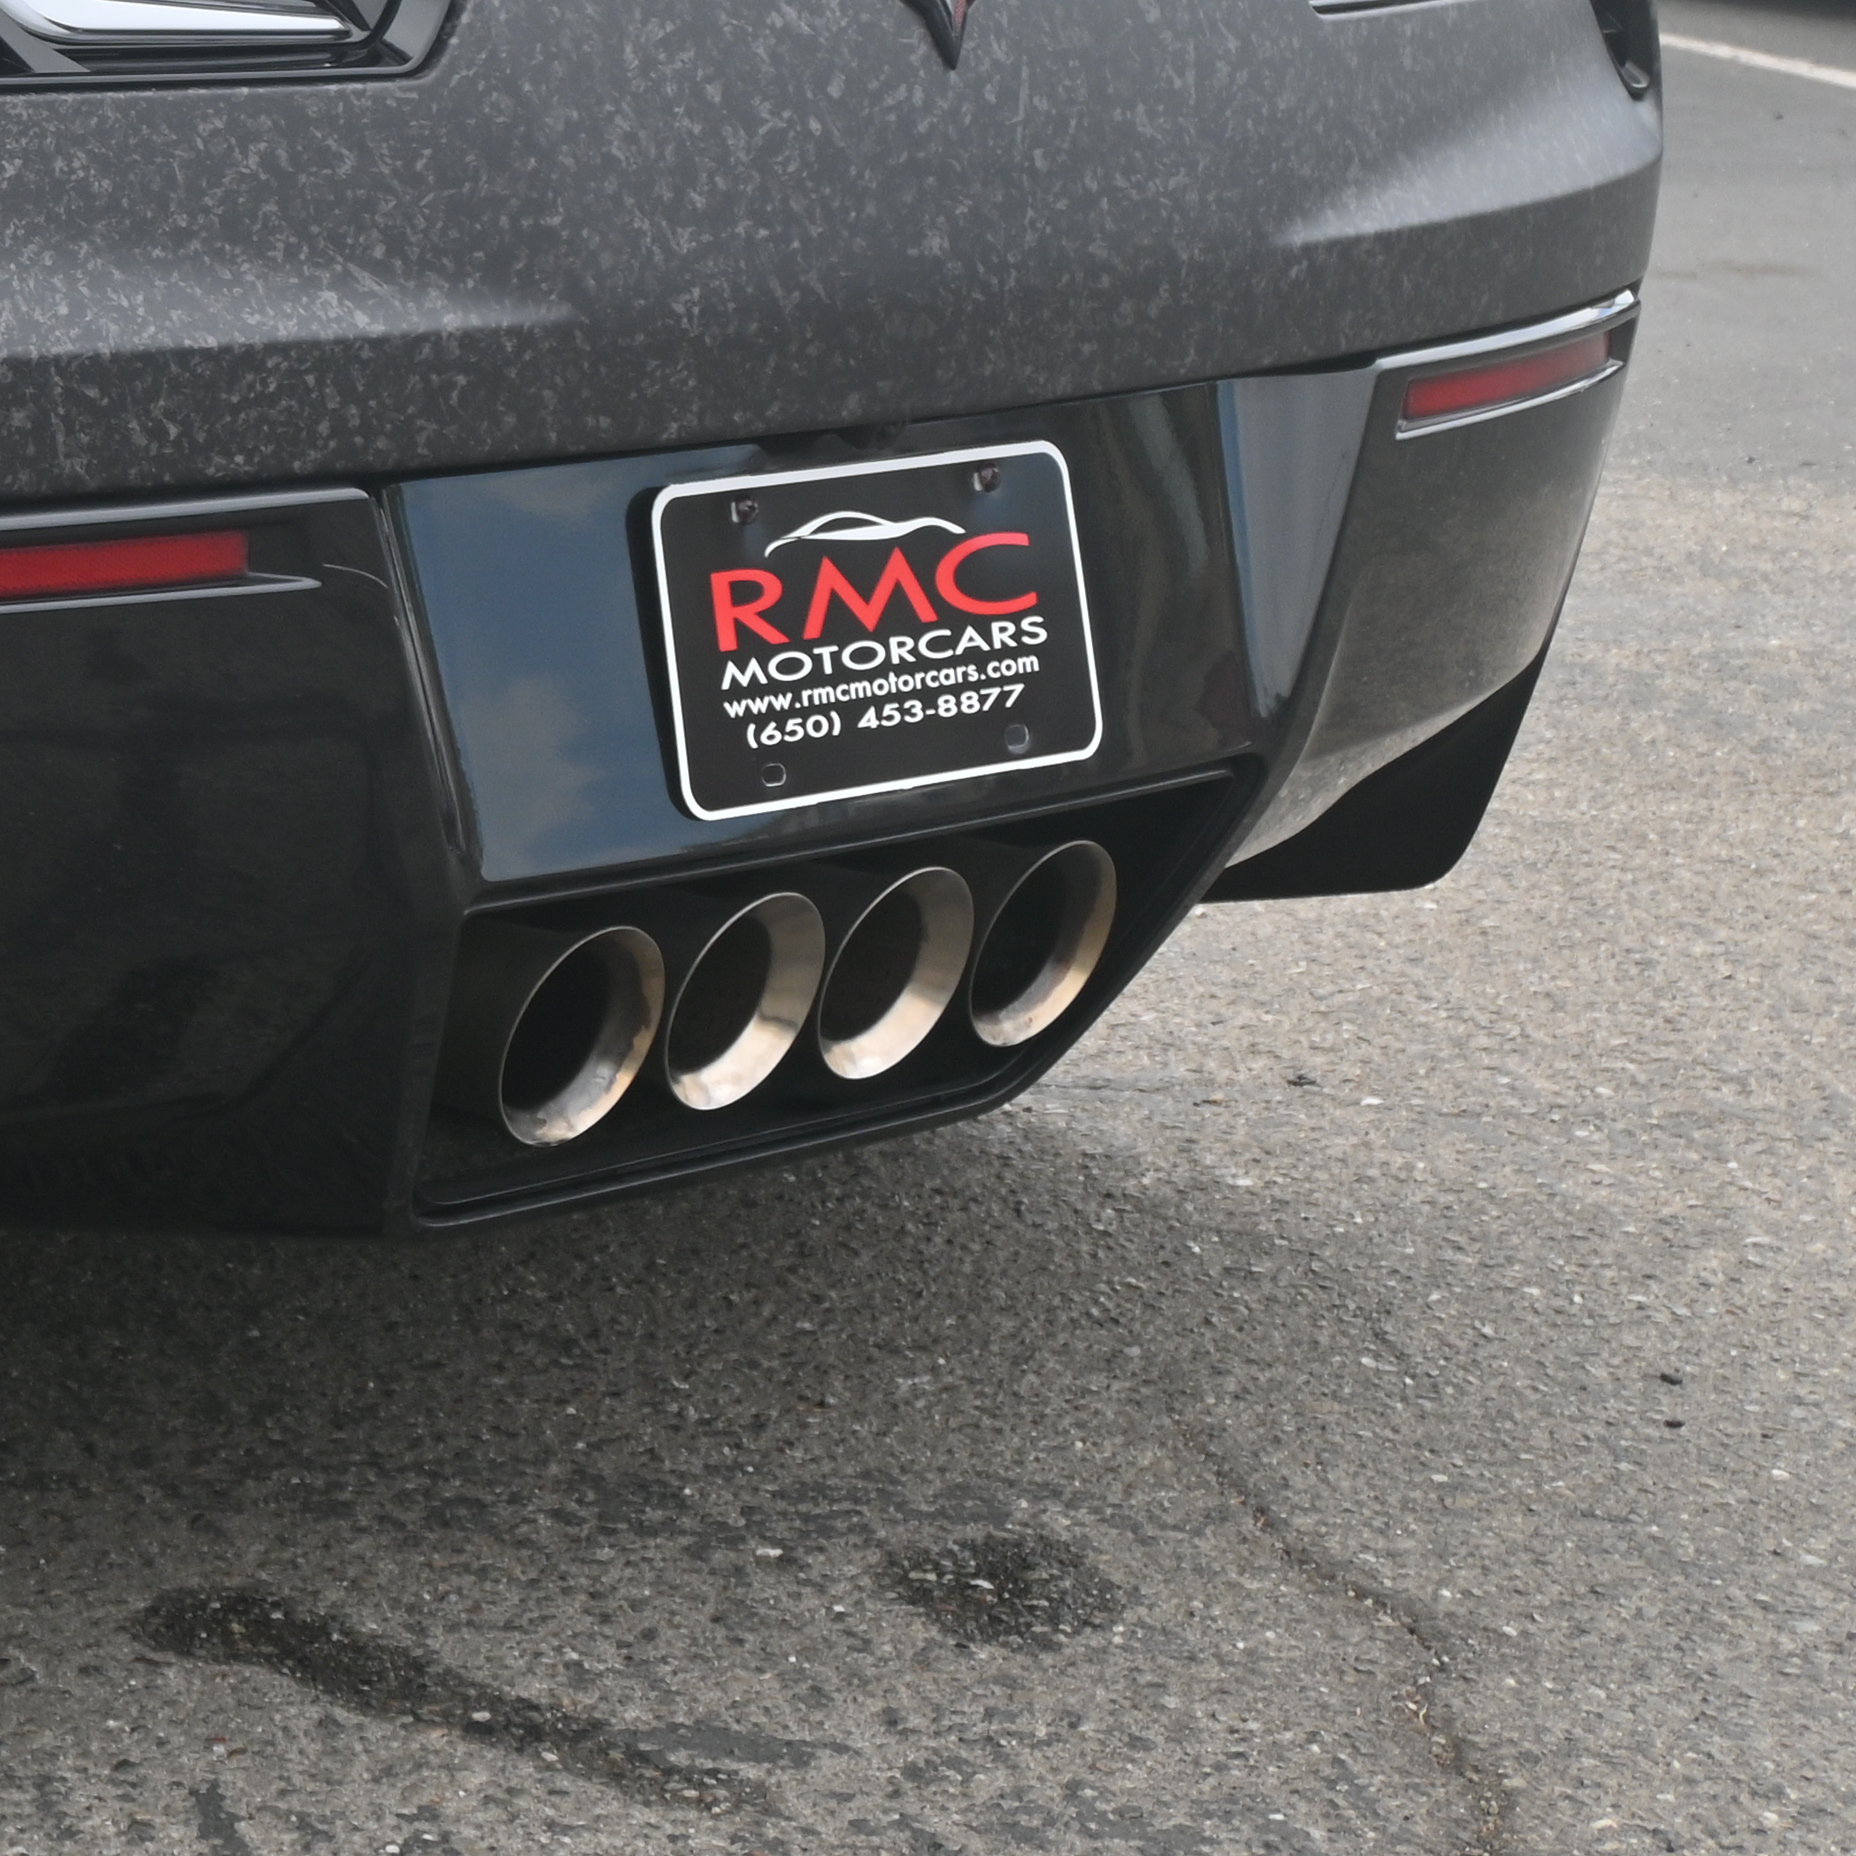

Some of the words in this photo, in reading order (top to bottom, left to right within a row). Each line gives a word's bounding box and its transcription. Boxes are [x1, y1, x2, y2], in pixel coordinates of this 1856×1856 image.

[710, 531, 1040, 653] RMC
[720, 615, 1049, 691] MOTORCARS
[722, 654, 1040, 719] www.rmcmotorcars.com
[746, 711, 842, 749] (650)
[856, 683, 1026, 730] 453-8877
